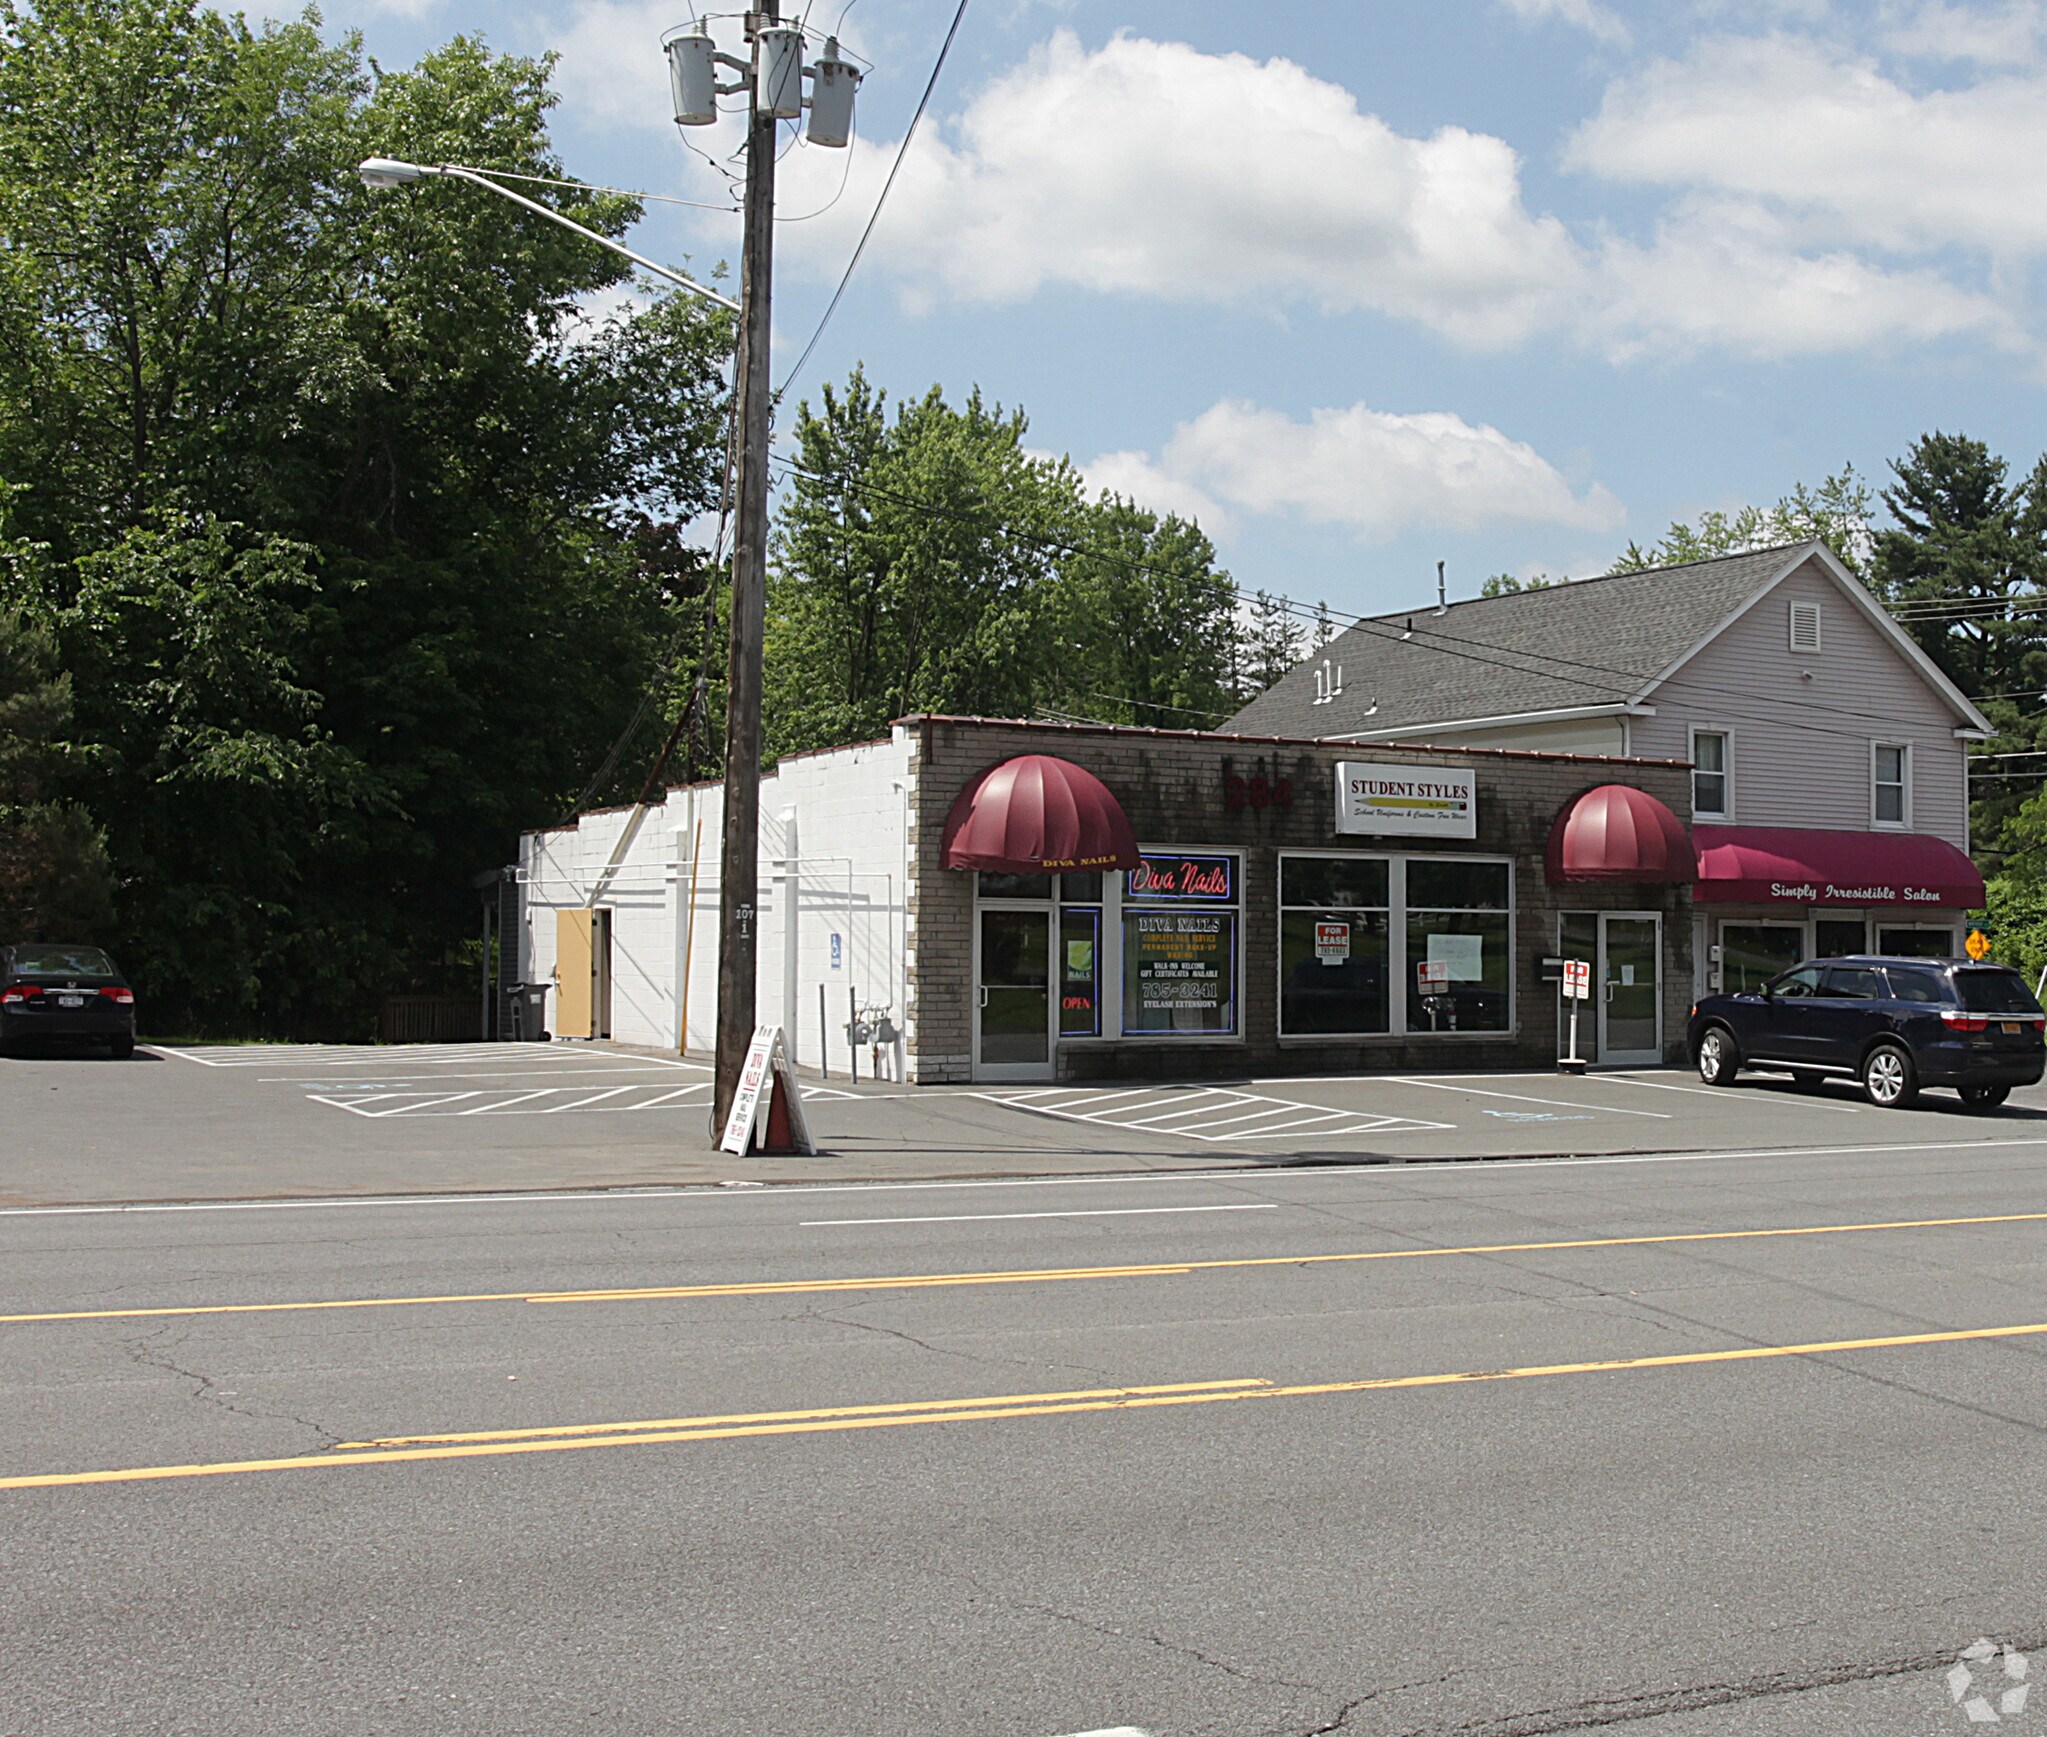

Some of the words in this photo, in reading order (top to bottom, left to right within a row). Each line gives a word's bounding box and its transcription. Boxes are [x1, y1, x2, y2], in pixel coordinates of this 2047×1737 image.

[1351, 780, 1415, 796] STUDENT
[1417, 783, 1468, 799] STYLES
[1354, 808, 1375, 816] School
[1376, 808, 1404, 818] Uniforms
[1413, 811, 1435, 819] Custom
[1437, 812, 1449, 820] Fun
[1451, 812, 1467, 820] Wear
[1042, 859, 1075, 867] DIVA
[1080, 855, 1117, 866] NAILS
[1132, 860, 1175, 890] Diva
[1180, 862, 1228, 894] Nails
[1771, 883, 1817, 900] Simply
[1825, 884, 1896, 899] Irresistible
[1903, 887, 1940, 901] Salon
[735, 909, 754, 919] 107
[1139, 917, 1173, 932] DIVA
[1177, 917, 1220, 933] NAILS
[1325, 927, 1342, 935] FOR
[1318, 936, 1347, 945] LEASE
[1142, 943, 1183, 951] PERMANENT
[1153, 962, 1179, 970] WALK-INS
[1181, 962, 1205, 970] WELCOME
[1569, 965, 1584, 975] FR
[1069, 970, 1091, 979] NAILS
[1140, 970, 1152, 978] GIFT
[1154, 970, 1189, 978] CERTIFICATES
[1192, 970, 1218, 978] AVAILABLE
[1564, 974, 1588, 984] LESE
[1142, 982, 1218, 998] 785-3241
[1062, 996, 1091, 1009] OPEN
[1143, 1000, 1174, 1008] EYELASH
